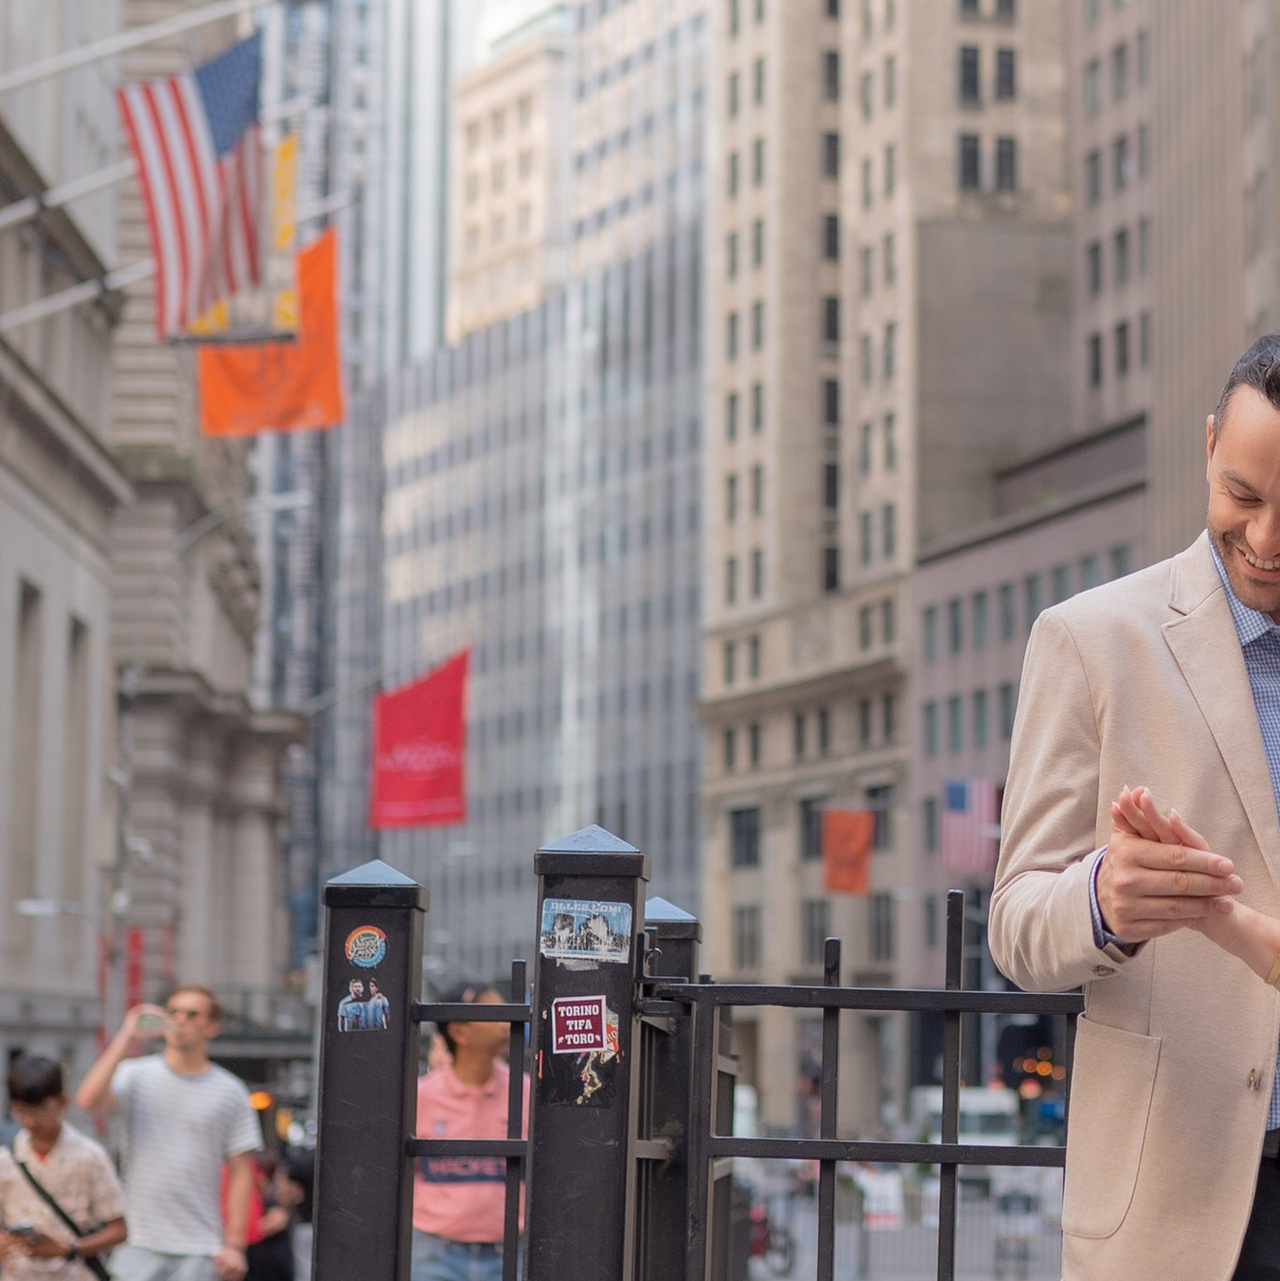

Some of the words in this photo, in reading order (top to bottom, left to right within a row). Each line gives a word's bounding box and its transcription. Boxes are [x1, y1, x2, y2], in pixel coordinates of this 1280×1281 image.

[557, 1004, 600, 1017] TORINO
[566, 1019, 593, 1031] TIFA
[565, 1033, 595, 1045] TORO
